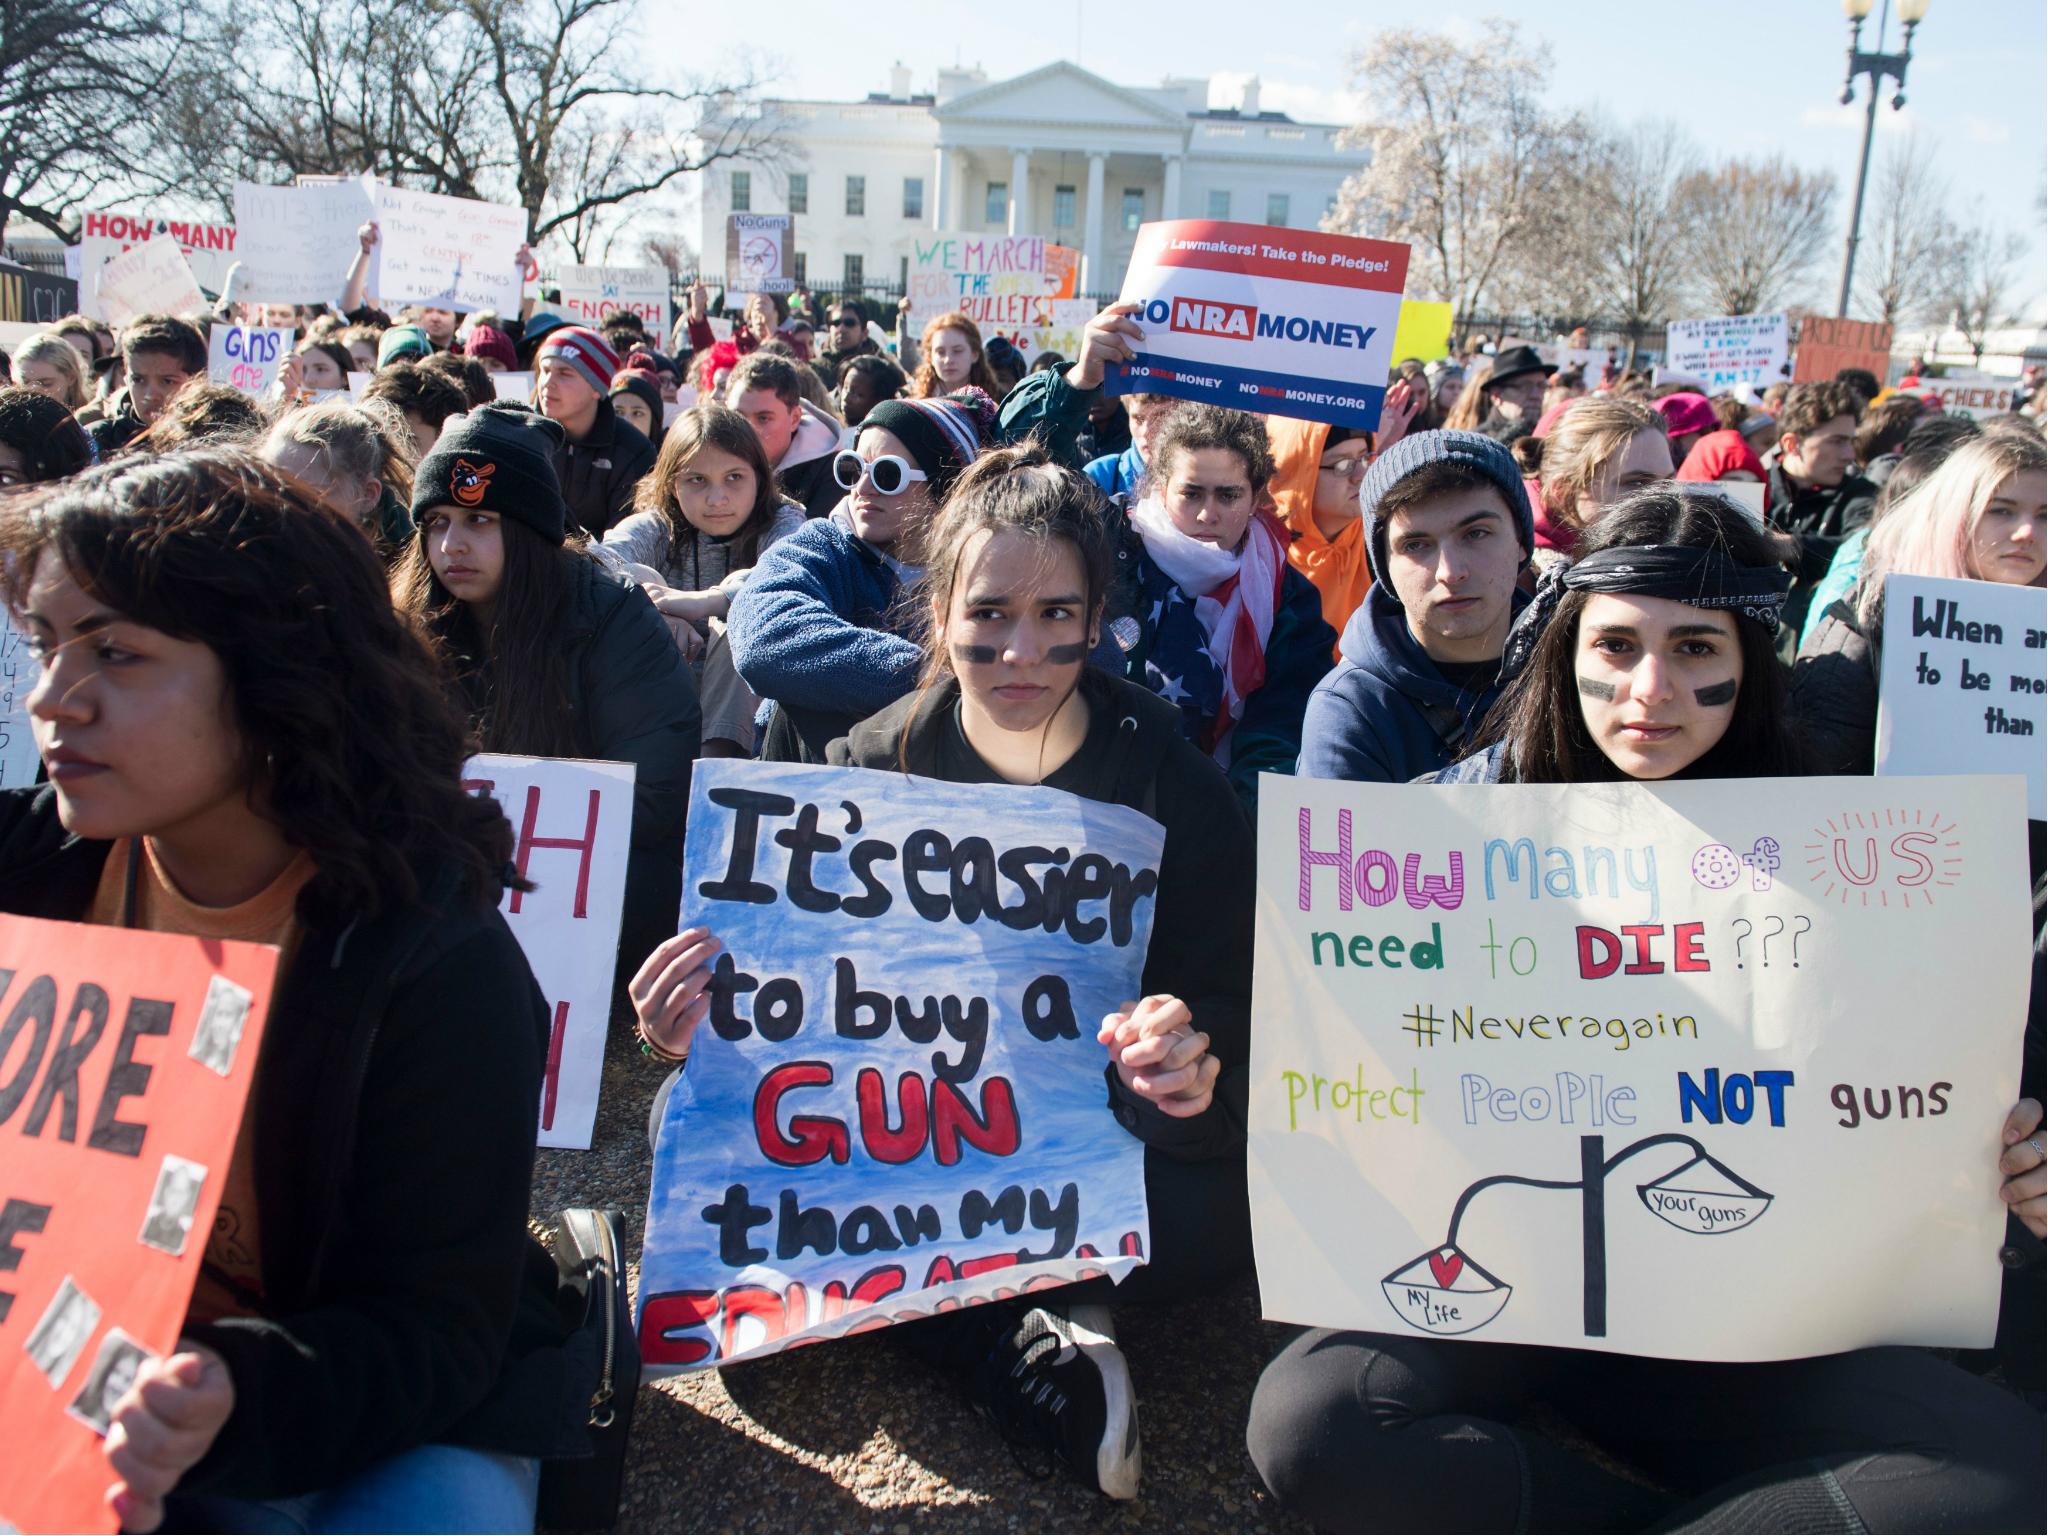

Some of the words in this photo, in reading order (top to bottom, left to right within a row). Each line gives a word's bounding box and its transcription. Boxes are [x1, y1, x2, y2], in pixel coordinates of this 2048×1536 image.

[87, 213, 152, 241] HOW
[169, 221, 237, 251] MANY
[735, 216, 753, 227] No
[756, 217, 787, 229] Guns
[915, 239, 957, 270] WE
[964, 237, 1044, 273] MARCH
[1170, 238, 1257, 256] Lawmakers!
[1261, 244, 1297, 261] Take
[1301, 250, 1327, 265] the
[1330, 253, 1389, 273] Pledge!
[911, 273, 950, 298] FOR
[953, 273, 992, 296] THE
[960, 294, 1043, 327] BULLETS
[1176, 302, 1250, 336] NRA
[1257, 313, 1378, 350] MONEY
[231, 363, 263, 390] are
[1931, 387, 2009, 410] CHERS
[1912, 595, 2003, 645] When
[1916, 651, 1941, 685] to
[1960, 658, 1991, 691] be
[2010, 674, 2047, 694] mo
[1984, 706, 2034, 736] than
[699, 787, 897, 918] It's
[903, 828, 1158, 947] easier
[1299, 807, 1464, 912] How
[1834, 831, 1938, 887] US
[1311, 922, 1444, 970] need
[1480, 918, 1537, 979] to
[1575, 921, 1711, 980] DIE
[1732, 915, 1811, 970] ???
[709, 952, 803, 1042] to
[835, 956, 989, 1084] buy
[1022, 974, 1080, 1042] a
[1402, 1004, 1698, 1051] #Neveragain
[0, 968, 176, 1158] ORE
[754, 1060, 1022, 1167] GUN
[1677, 1067, 1795, 1128] NOT
[1830, 1081, 1953, 1129] guns
[701, 1184, 941, 1267] than
[1698, 1204, 1747, 1230] guns
[1424, 1305, 1462, 1326] Life
